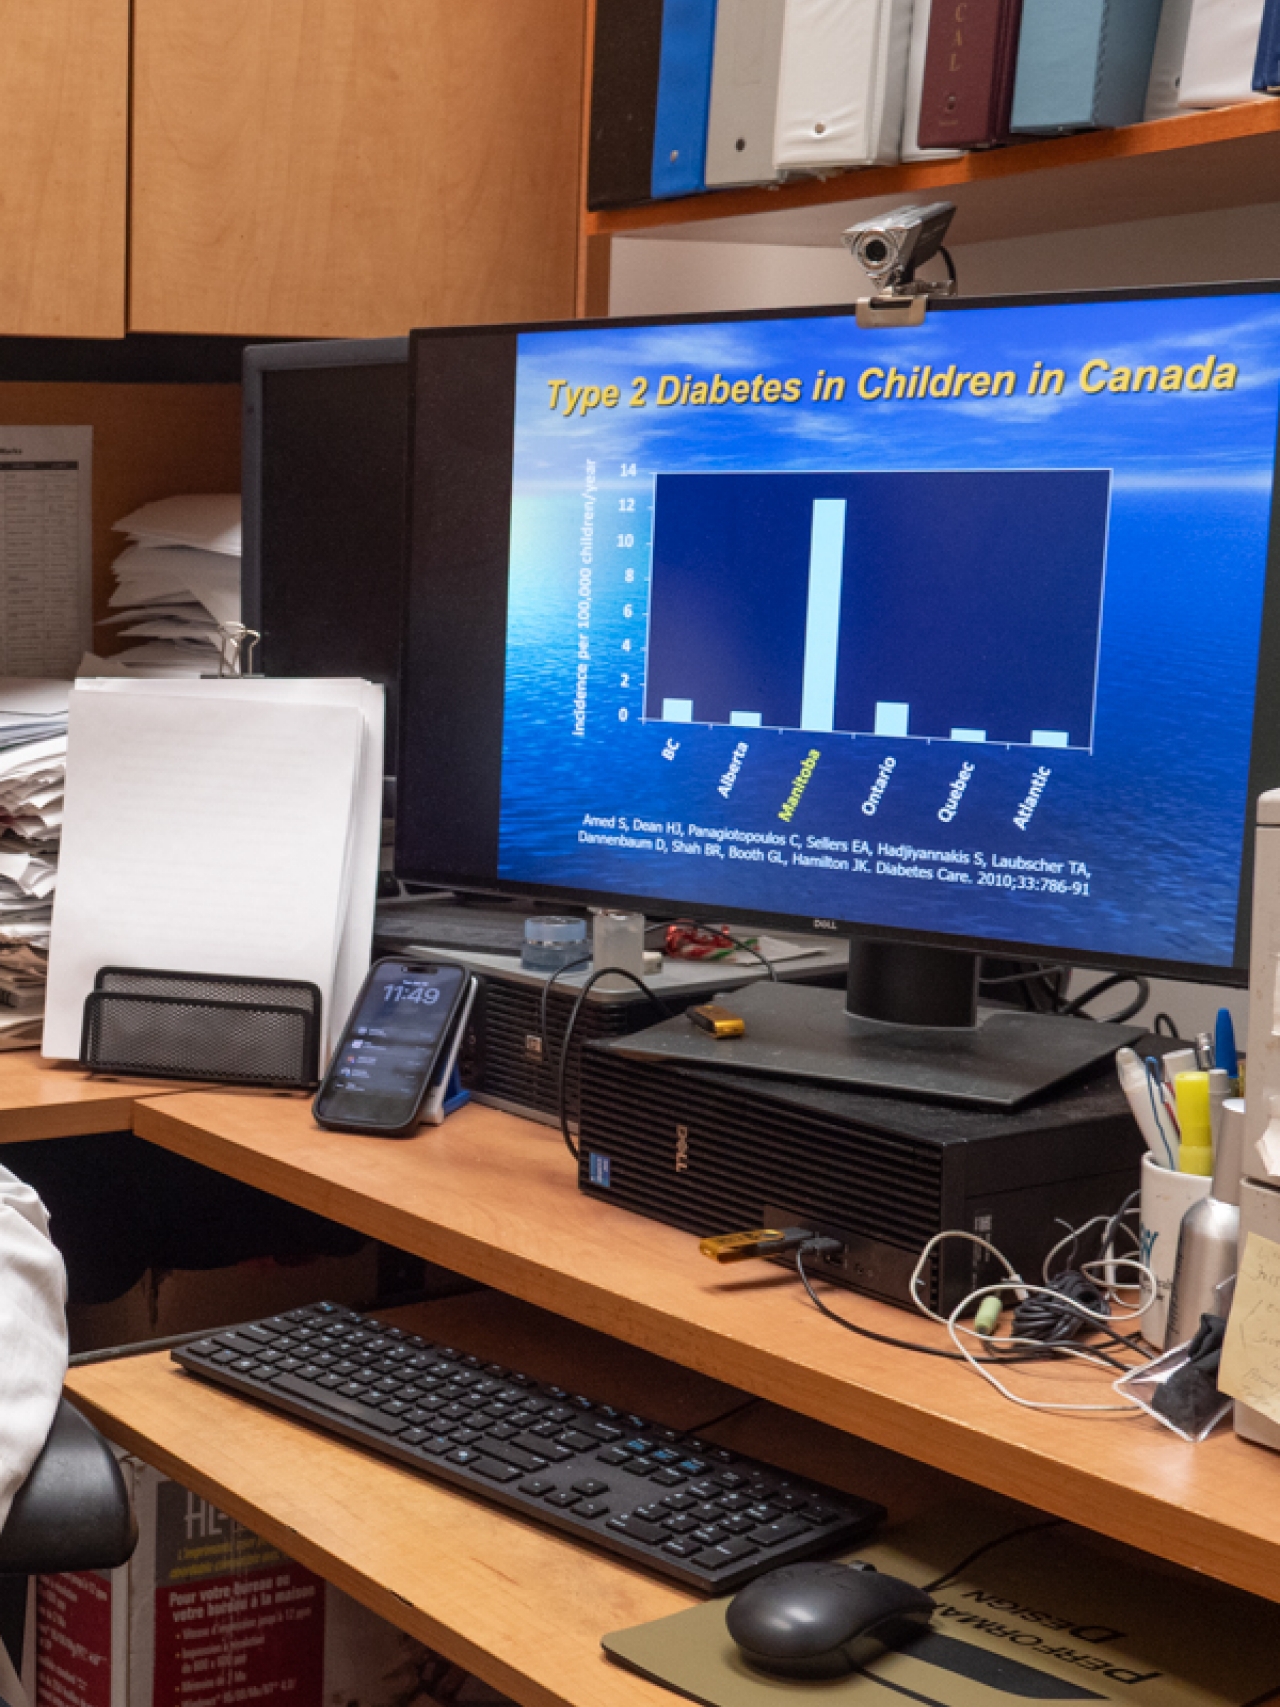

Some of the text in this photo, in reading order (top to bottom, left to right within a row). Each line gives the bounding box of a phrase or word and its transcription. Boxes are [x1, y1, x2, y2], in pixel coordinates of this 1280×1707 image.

[547, 355, 1238, 417] Type 2 Diabetes in Children in Canada
[620, 463, 637, 477] 14
[618, 498, 635, 512] 12
[616, 534, 634, 548] 10
[624, 568, 635, 582] 8
[572, 459, 597, 736] Incidence per 100,000 children/year
[623, 604, 632, 618] 6
[621, 638, 632, 652] 4
[620, 674, 629, 688] 2
[618, 708, 628, 722] 0
[660, 738, 680, 761] BC
[717, 741, 750, 799] Alberta
[777, 748, 821, 823] Manitoba
[861, 756, 897, 816] Ontario
[937, 761, 976, 823] Quebec
[1012, 765, 1052, 831] Atlantic
[582, 813, 1092, 878] Amed S, Dean HJ, Panagiotopoulos C, Sellers EA, Hadjiyannakis S, Laubscher TA,
[578, 830, 1090, 897] Dannenbaum D, Shah BR, Booth GL, Hamilton JK. Diabetes Care. 2010;33:786-91
[813, 918, 837, 930] DELL
[384, 984, 440, 1005] 11:49
[676, 1124, 688, 1172] DELL
[169, 1591, 196, 1608] Pour
[199, 1585, 231, 1602] votre
[276, 1574, 291, 1588] ou
[172, 1606, 204, 1622] votre
[274, 1585, 316, 1604] maison
[961, 1589, 1128, 1644] DESIGN
